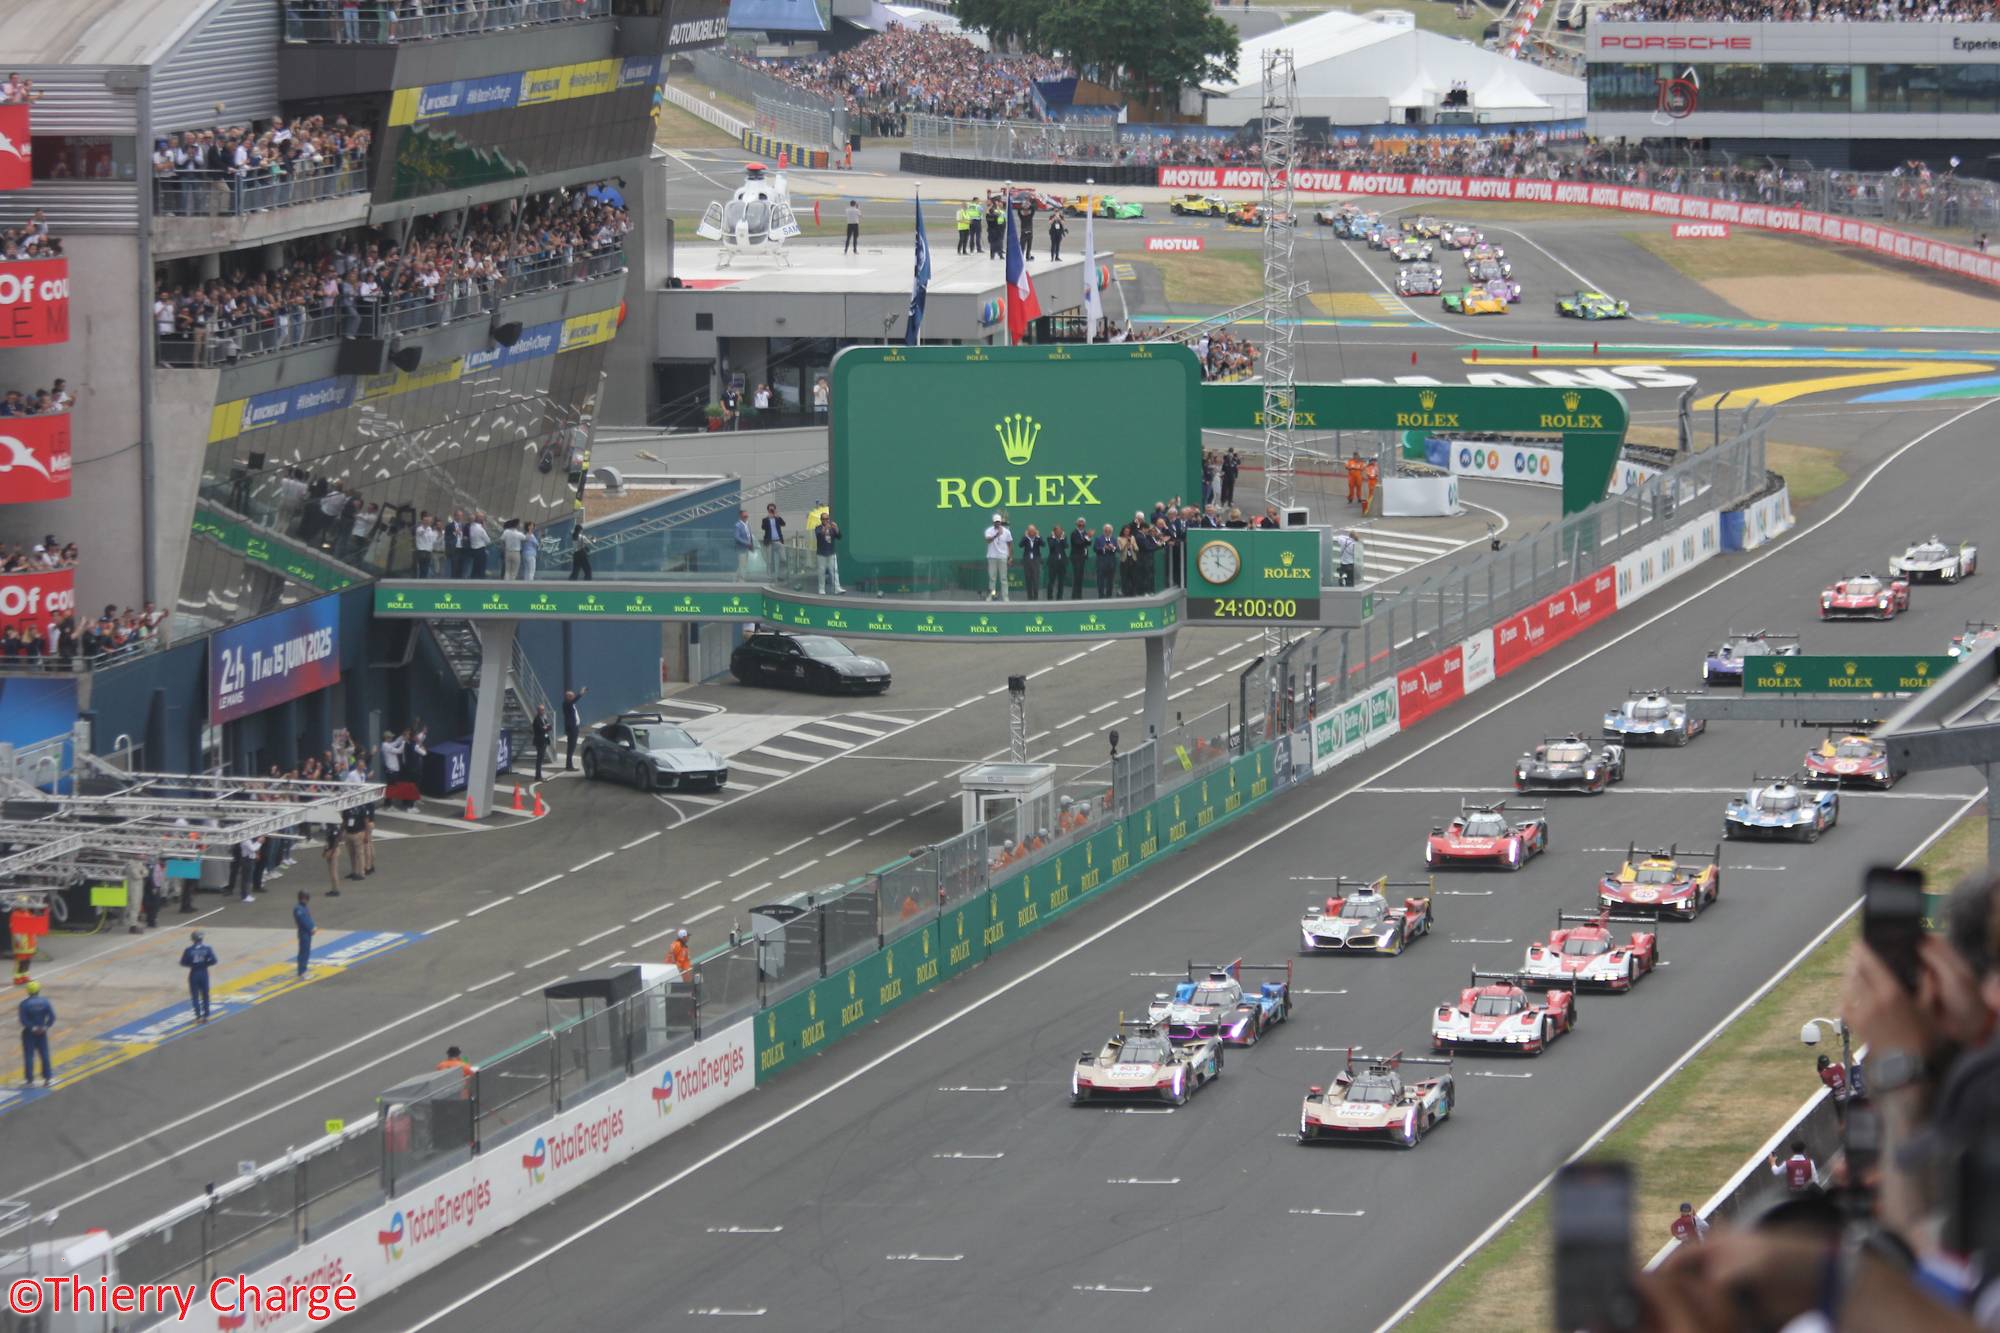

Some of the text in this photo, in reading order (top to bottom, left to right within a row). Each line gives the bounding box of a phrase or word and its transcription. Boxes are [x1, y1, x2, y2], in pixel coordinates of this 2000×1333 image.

[1601, 36, 1752, 49] PORSCHE
[1953, 37, 2000, 53] Experie
[1162, 170, 1218, 187] MOTUL
[1223, 170, 1284, 188] MOT
[1347, 175, 1406, 194] MOTUL
[1411, 177, 1464, 196] MOTUL
[1467, 181, 1511, 198] MOTUL
[1515, 183, 1553, 200] MOTUL
[1556, 185, 1589, 203] MOTUL
[1592, 187, 1619, 206] MOTUL
[1621, 191, 1650, 211] MOTUL
[1676, 225, 1726, 237] MOTUL
[1150, 239, 1200, 250] MOTUL
[0, 274, 35, 304] Of
[1396, 413, 1459, 427] ROLEX
[1540, 414, 1603, 428] ROLEX
[936, 474, 1102, 509] ROLEX
[1264, 568, 1311, 579] ROLEX
[0, 585, 40, 615] Of
[435, 602, 461, 610] ROLEX
[482, 603, 509, 611] ROLEX
[530, 603, 557, 611] ROLEX
[578, 604, 605, 612] ROLEX
[626, 604, 653, 613] ROLEX
[674, 605, 701, 613] ROLEX
[1214, 599, 1297, 618] 24:00:00
[722, 605, 749, 614] ROLEX
[827, 620, 848, 628] ROLEX
[868, 622, 893, 631] ROLEX
[917, 625, 944, 633] ROLEX
[970, 625, 998, 633] ROLEX
[1025, 625, 1053, 633] ROLEX
[1080, 623, 1106, 632] ROLEX
[1130, 621, 1154, 630] ROLEX
[252, 650, 262, 681] 11
[262, 656, 273, 678] AU
[274, 643, 284, 674] 15
[284, 635, 306, 677] JUIN
[307, 627, 332, 663] 2025
[1758, 678, 1802, 688] ROLEX
[1828, 678, 1873, 688] ROLEX
[1899, 677, 1937, 688] ROLE
[1198, 806, 1215, 828] ROLEX
[1170, 820, 1187, 843] ROLEX
[1140, 836, 1158, 860] ROLEX
[1112, 852, 1129, 876] ROLEX
[1081, 867, 1099, 892] ROLEX
[1050, 884, 1069, 910] ROLEX
[1018, 901, 1038, 927] ROLEX
[984, 921, 1004, 947] ROLEX
[950, 940, 970, 966] ROLEX
[917, 958, 938, 985] ROLEX
[880, 978, 902, 1005] ROLEX
[842, 999, 864, 1027] ROLEX
[802, 1020, 825, 1048] ROLEX
[761, 1042, 785, 1071] ROLEX
[674, 1042, 744, 1102] TotalEnergies
[547, 1104, 624, 1170] TotalEnergies
[406, 1177, 491, 1248] TotalEnergies
